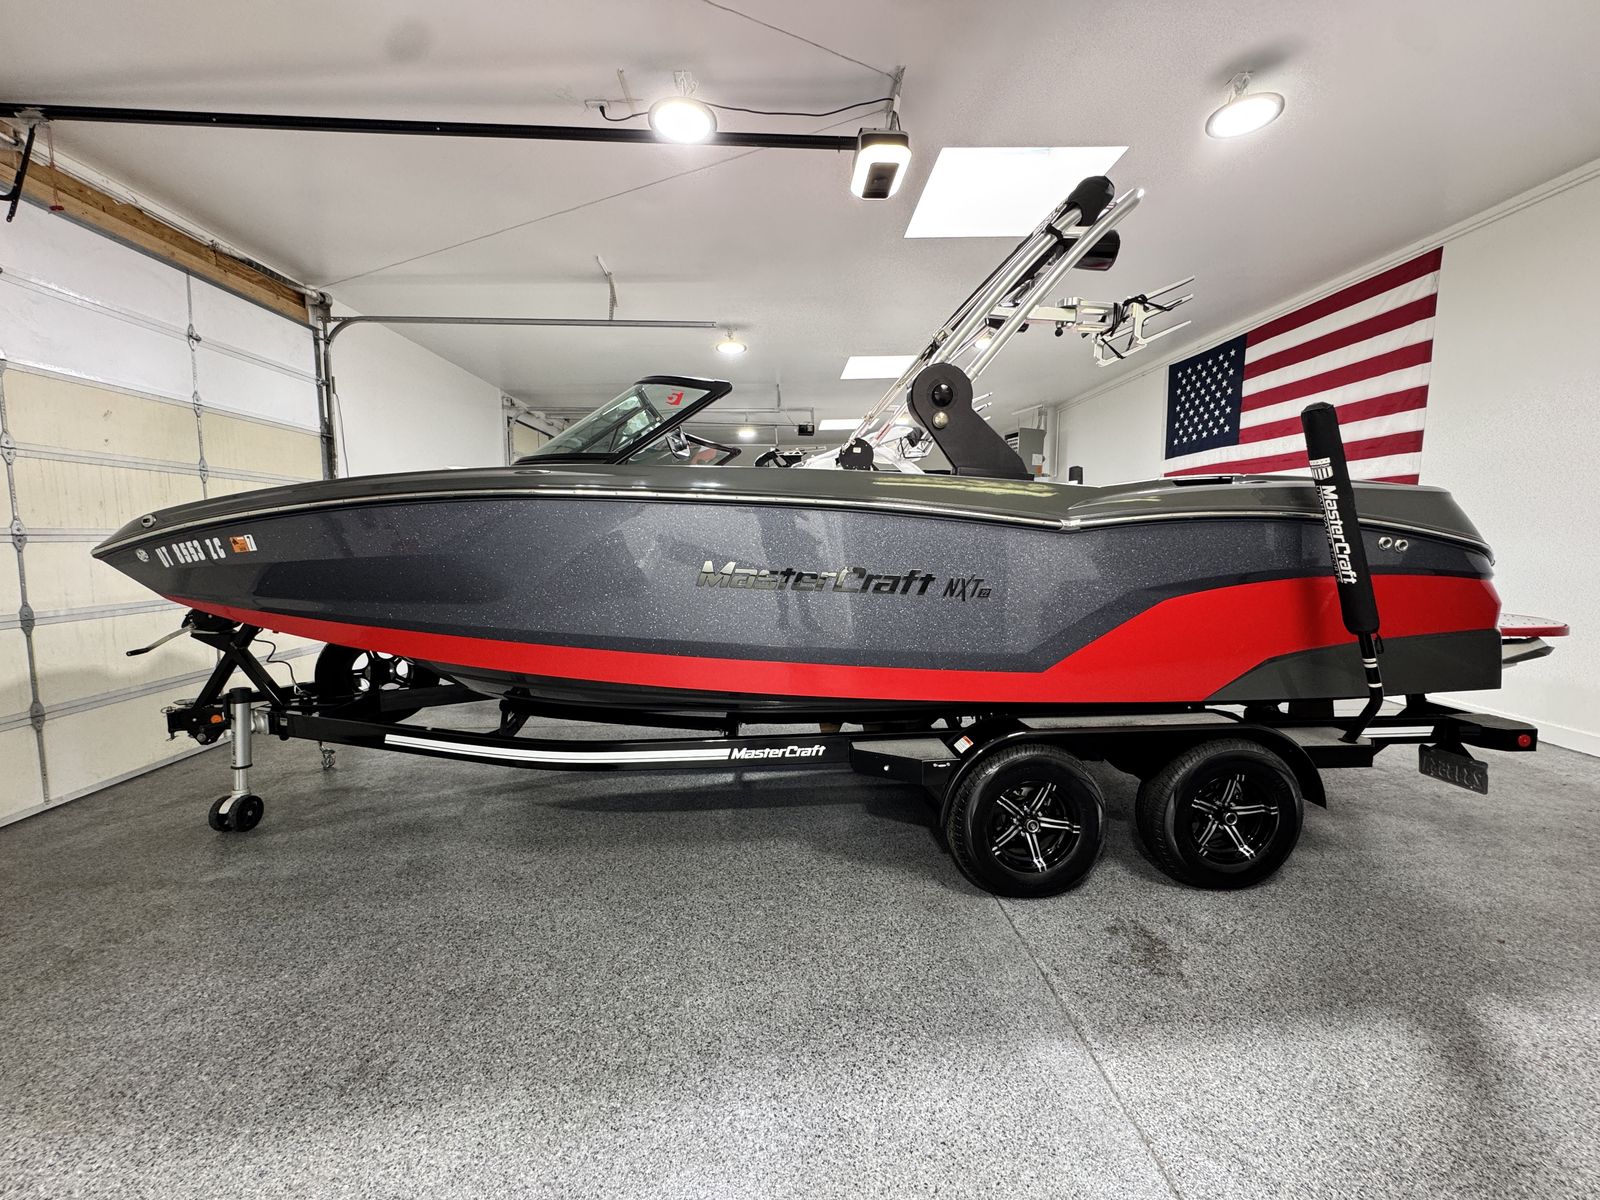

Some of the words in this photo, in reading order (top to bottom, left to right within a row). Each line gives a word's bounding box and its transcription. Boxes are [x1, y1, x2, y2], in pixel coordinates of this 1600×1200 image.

[1321, 485, 1357, 585] MasterCraft
[155, 546, 174, 568] UT
[697, 560, 936, 595] MasterCraft
[943, 574, 984, 601] NXT
[731, 745, 826, 760] MasterCraft
